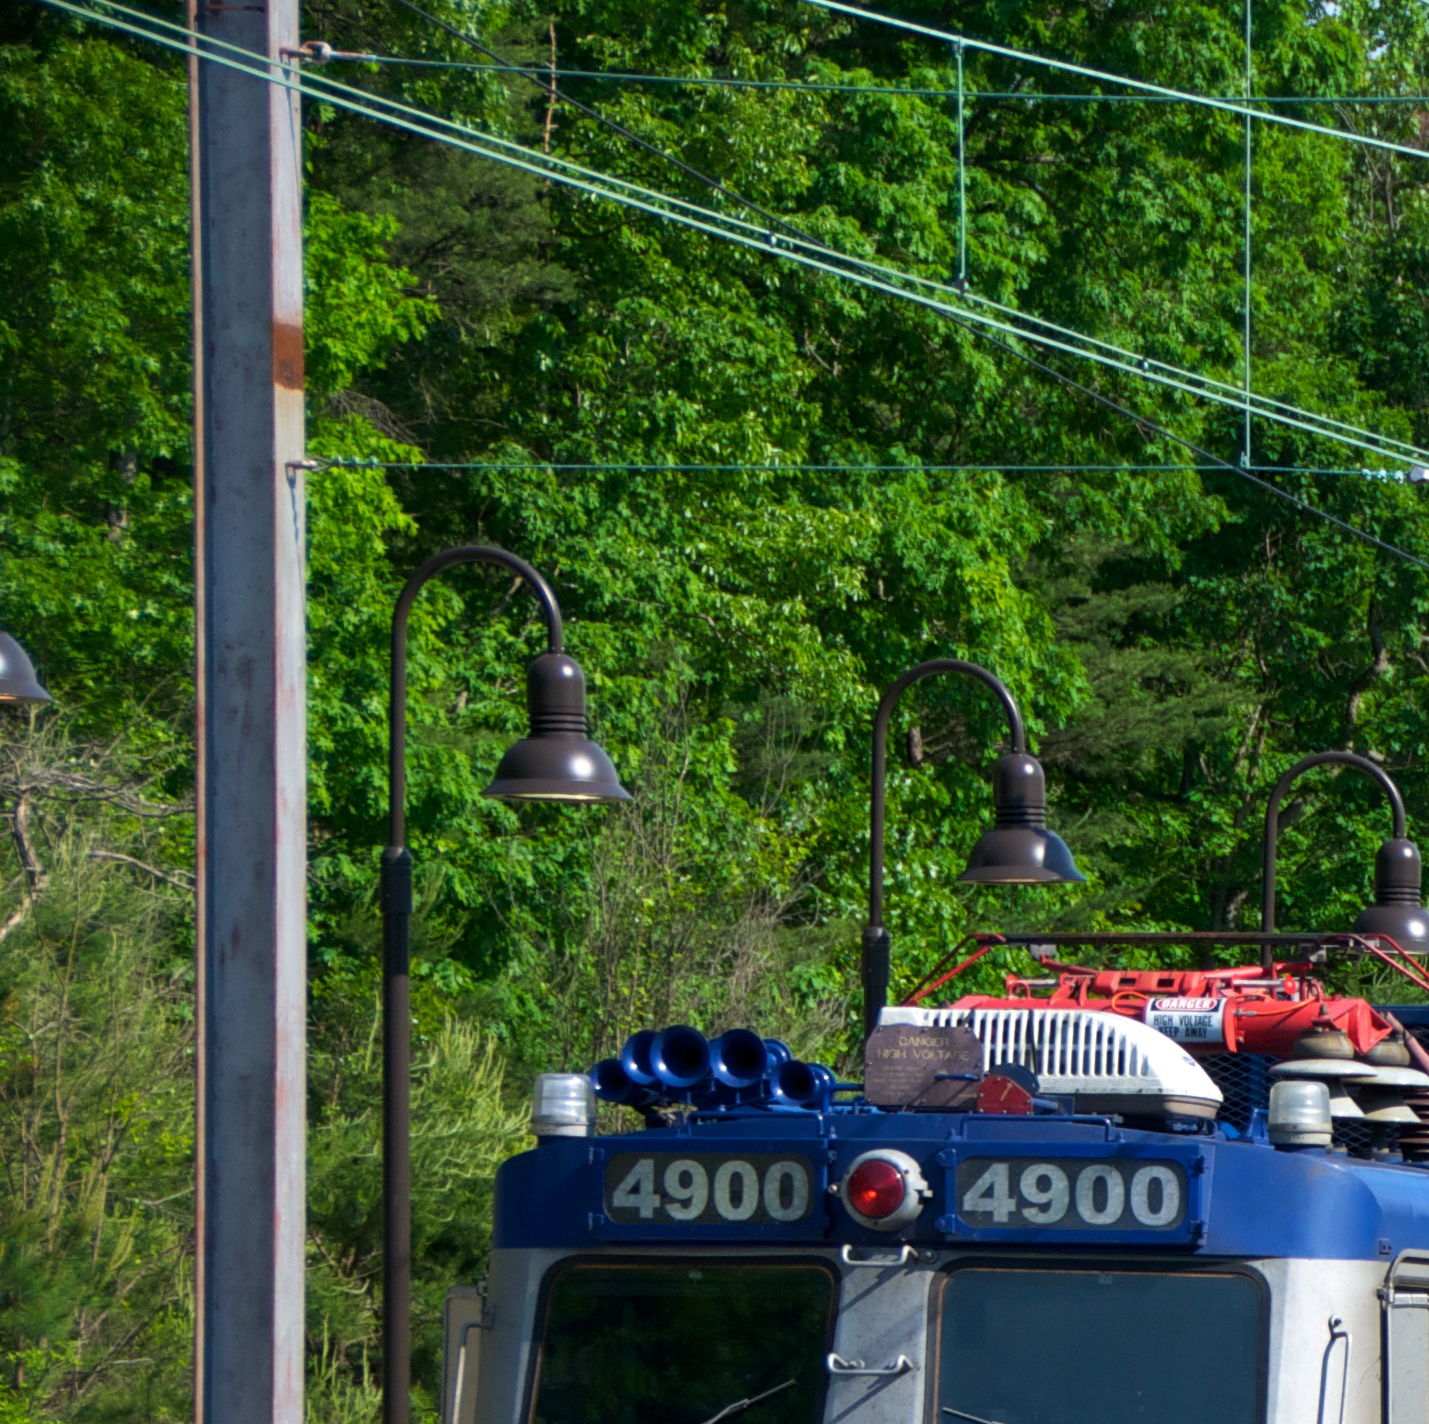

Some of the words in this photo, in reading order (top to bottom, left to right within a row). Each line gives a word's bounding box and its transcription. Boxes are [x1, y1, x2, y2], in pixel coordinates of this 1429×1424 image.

[1161, 999, 1211, 1010] DANGER
[1153, 1015, 1174, 1027] HIGH
[1179, 1015, 1213, 1028] VOLTAGE
[1184, 1027, 1208, 1039] AWAY
[898, 1037, 950, 1047] DANGER
[877, 1049, 907, 1059] HIGH
[912, 1050, 971, 1061] VOLTAGE
[612, 1158, 809, 1222] 4900
[962, 1162, 1181, 1227] 4900
